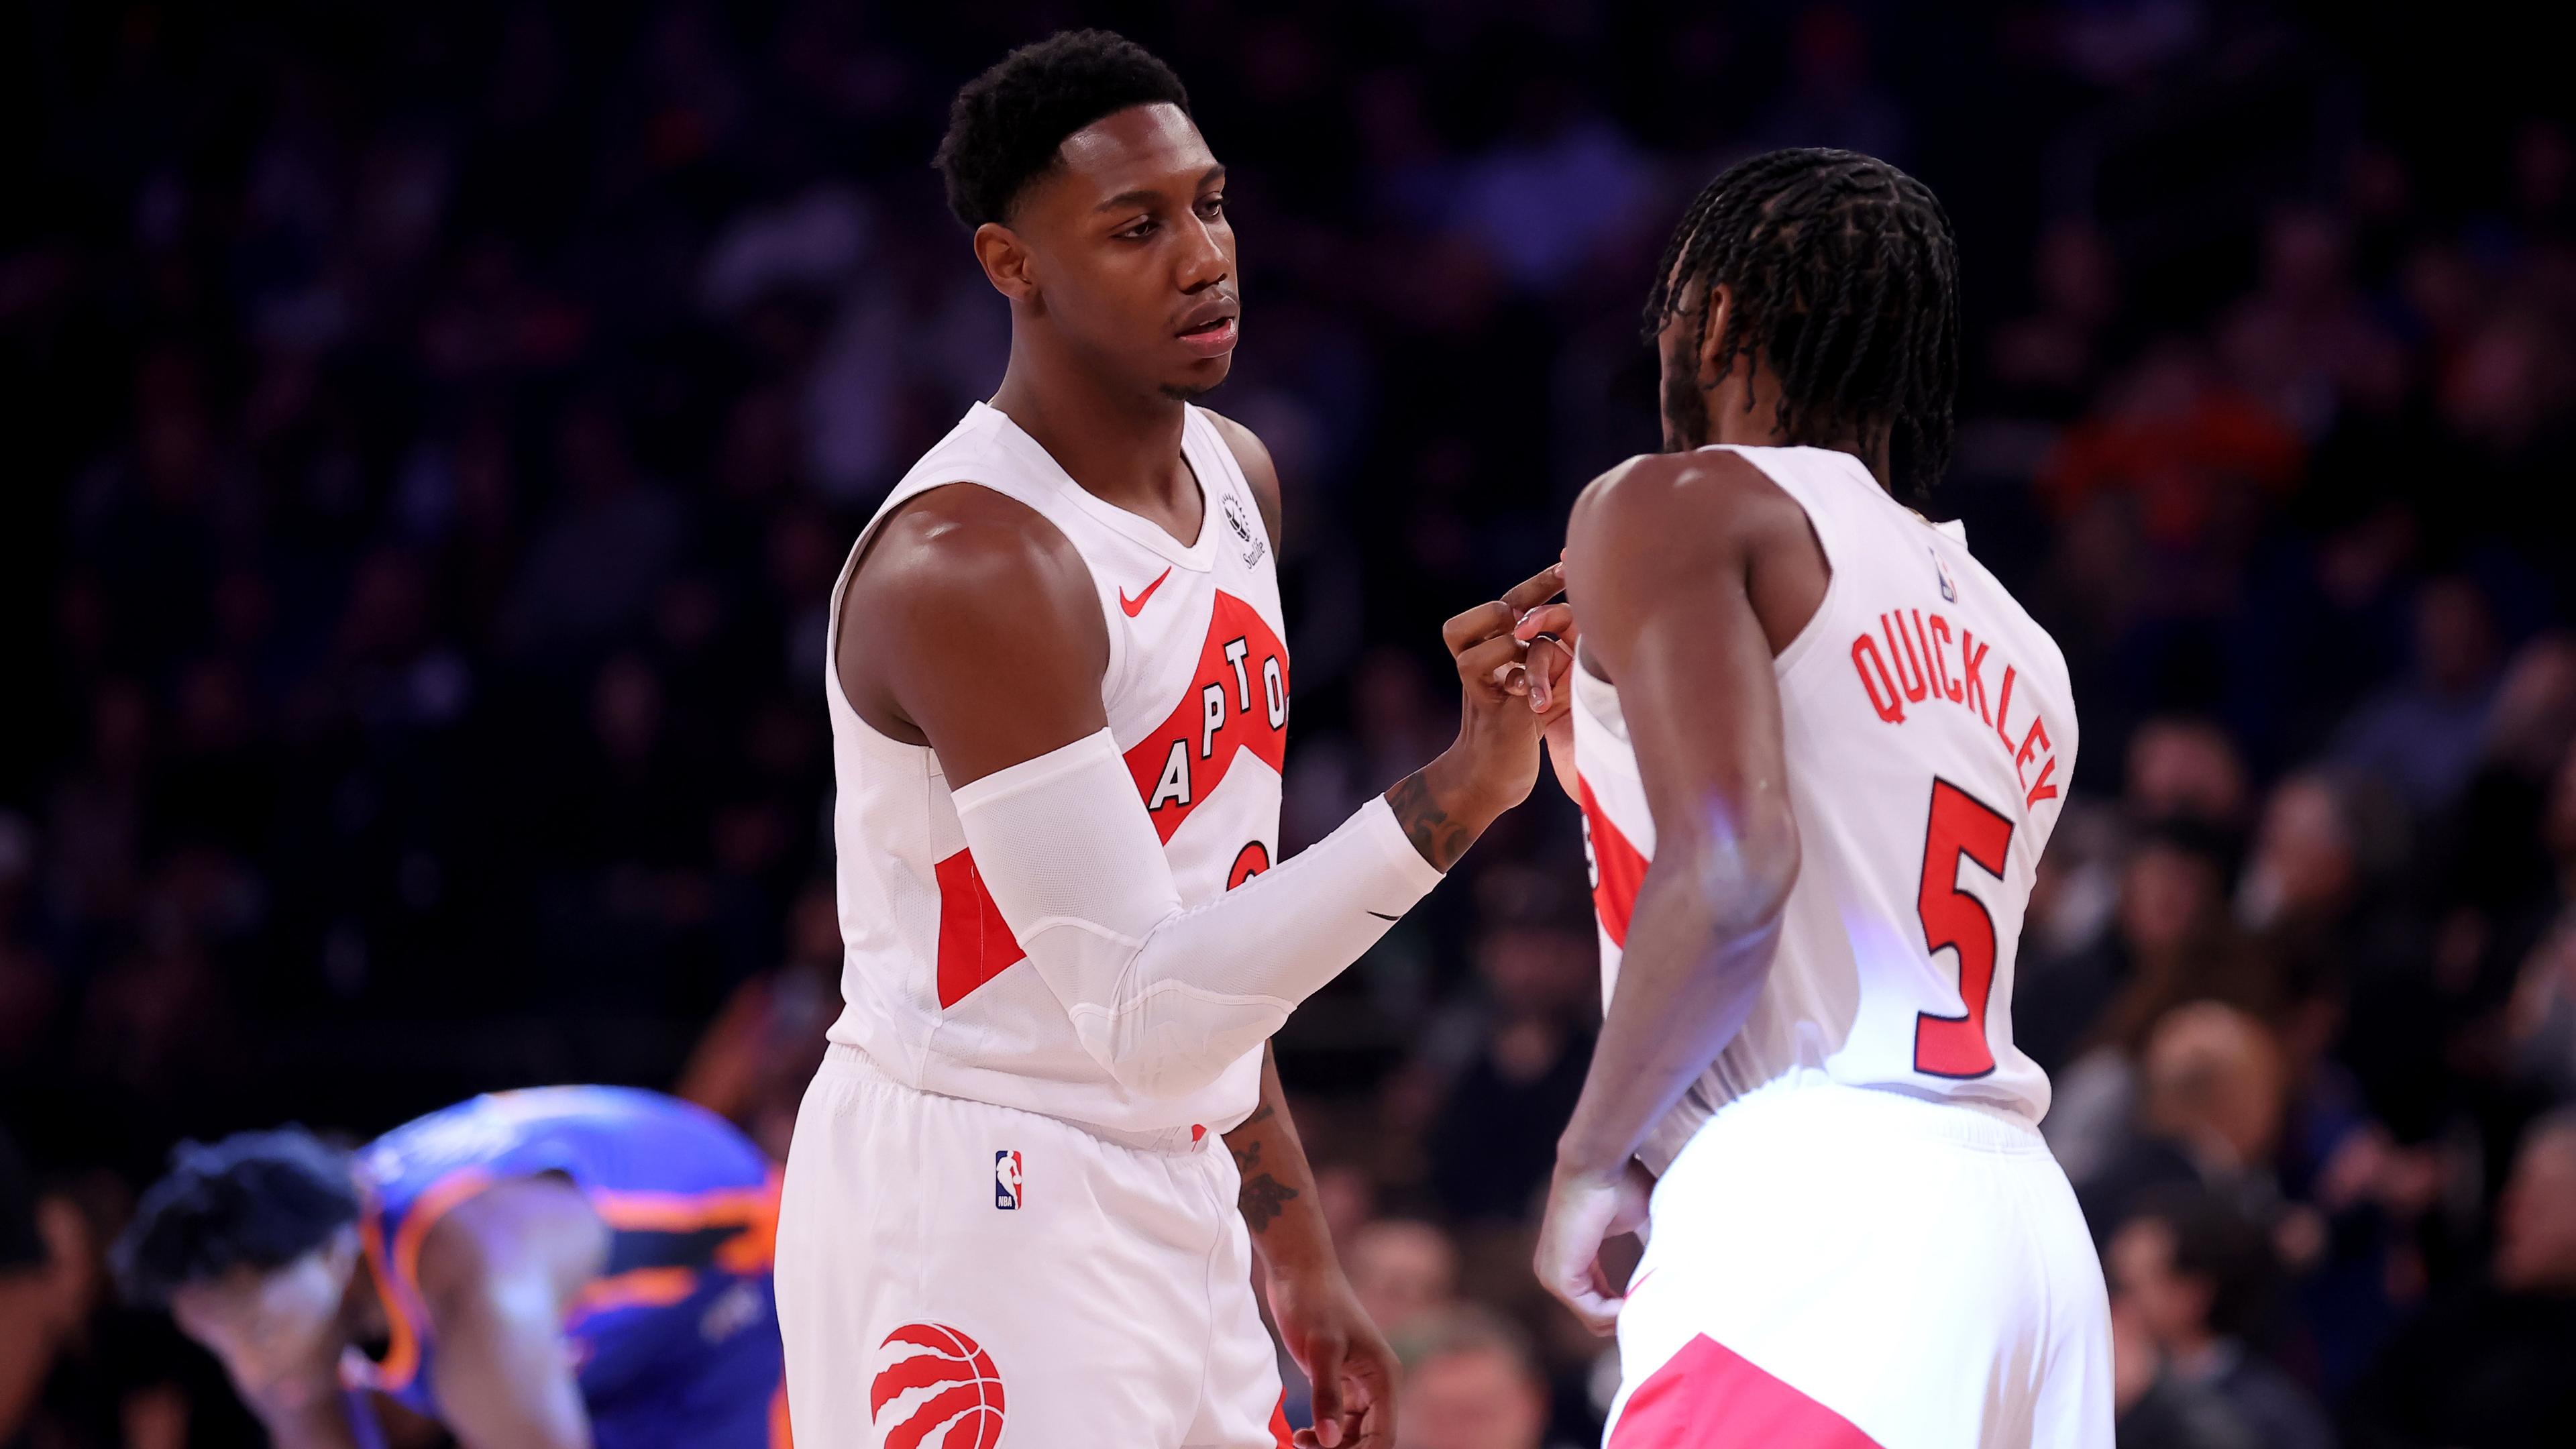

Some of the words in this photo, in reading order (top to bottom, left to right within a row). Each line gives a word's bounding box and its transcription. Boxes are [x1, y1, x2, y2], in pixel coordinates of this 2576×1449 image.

[1148, 635, 1289, 812] APTO
[1851, 608, 2058, 814] QUICKLEY
[1914, 773, 2015, 1079] 5
[998, 1195, 1012, 1207] NBA
